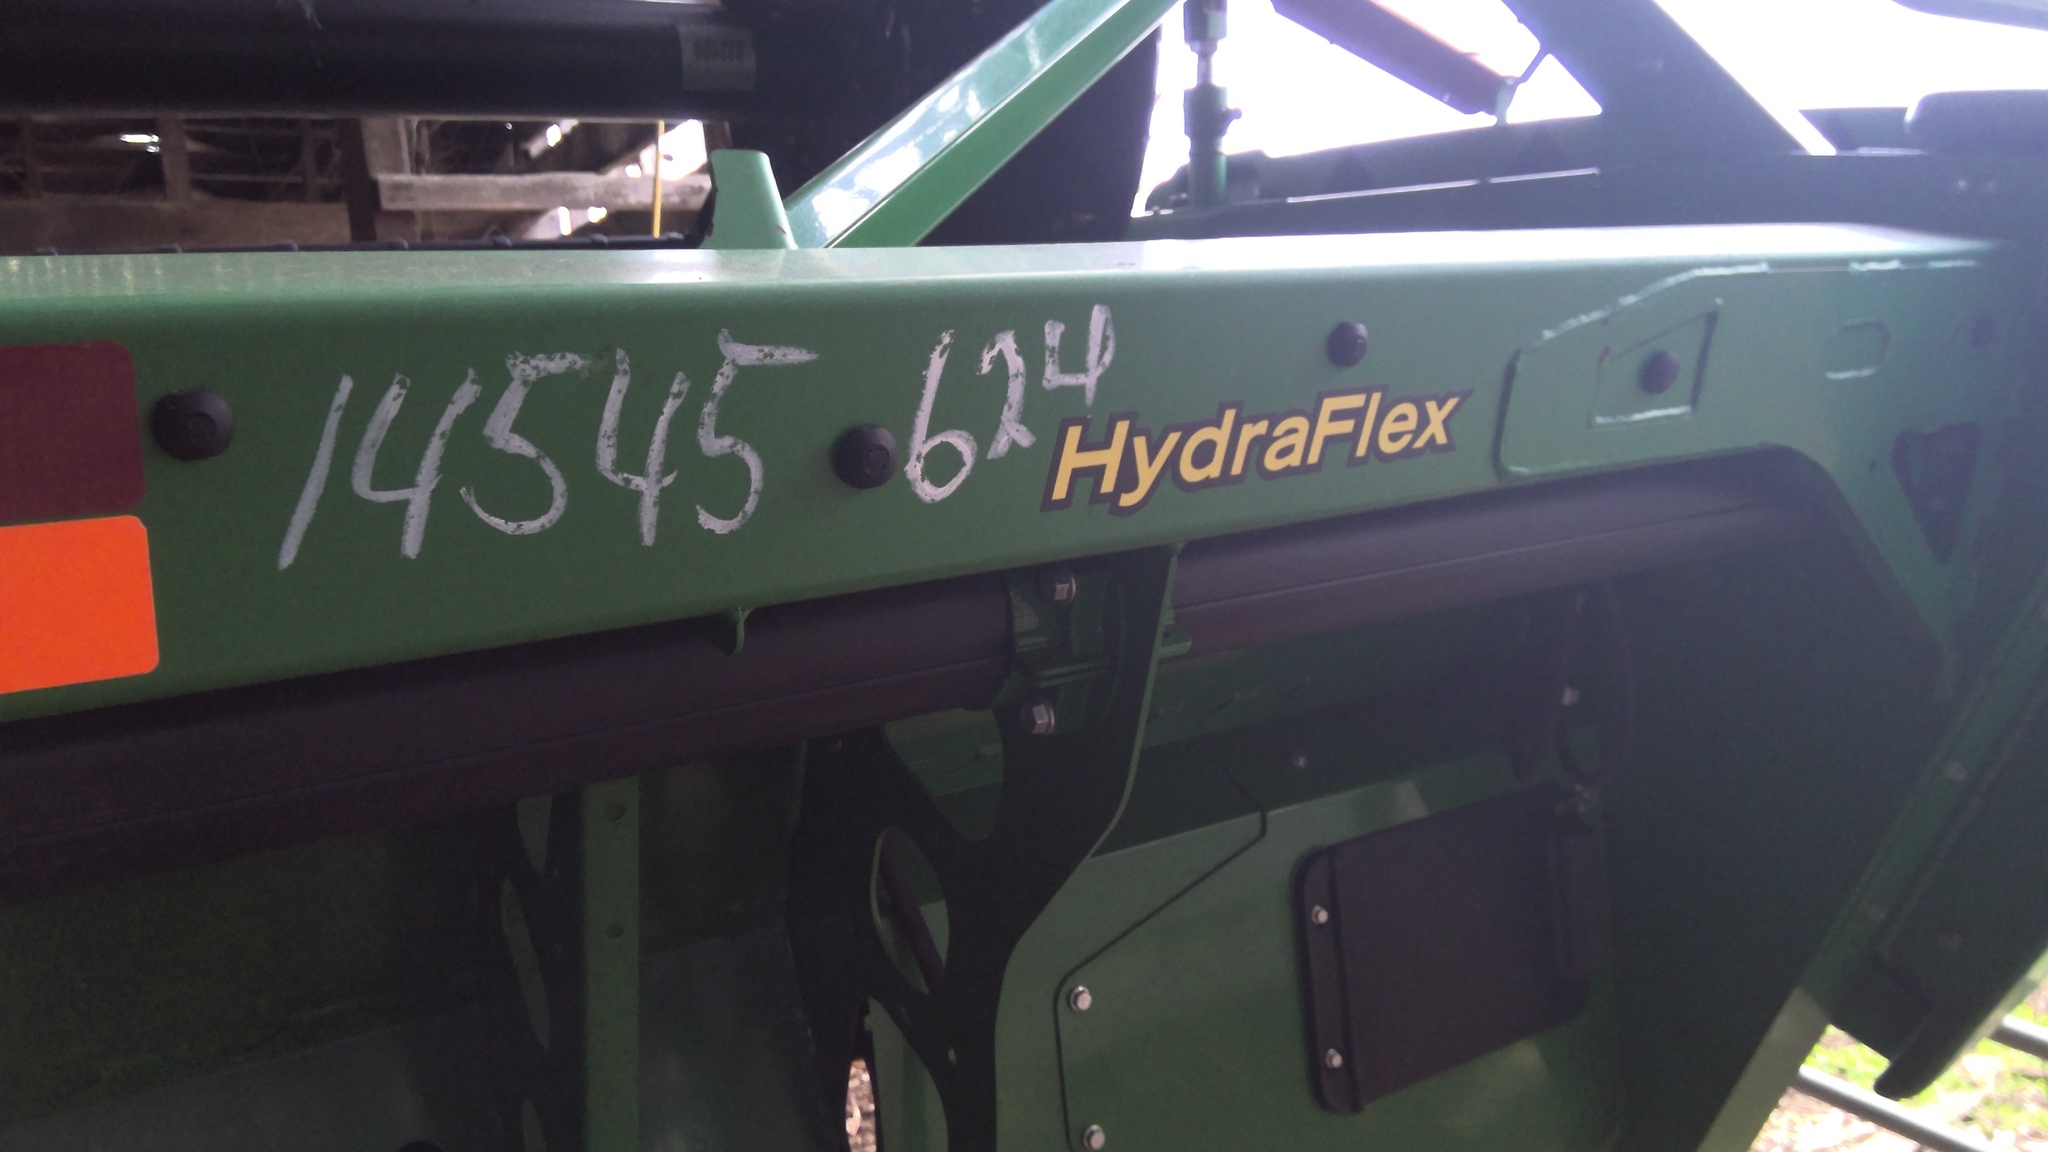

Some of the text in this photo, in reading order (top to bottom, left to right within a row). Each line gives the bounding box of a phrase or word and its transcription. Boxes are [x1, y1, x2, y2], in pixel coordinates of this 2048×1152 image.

[278, 303, 1116, 570] 14545 624
[1047, 388, 1465, 510] HydraFlex
